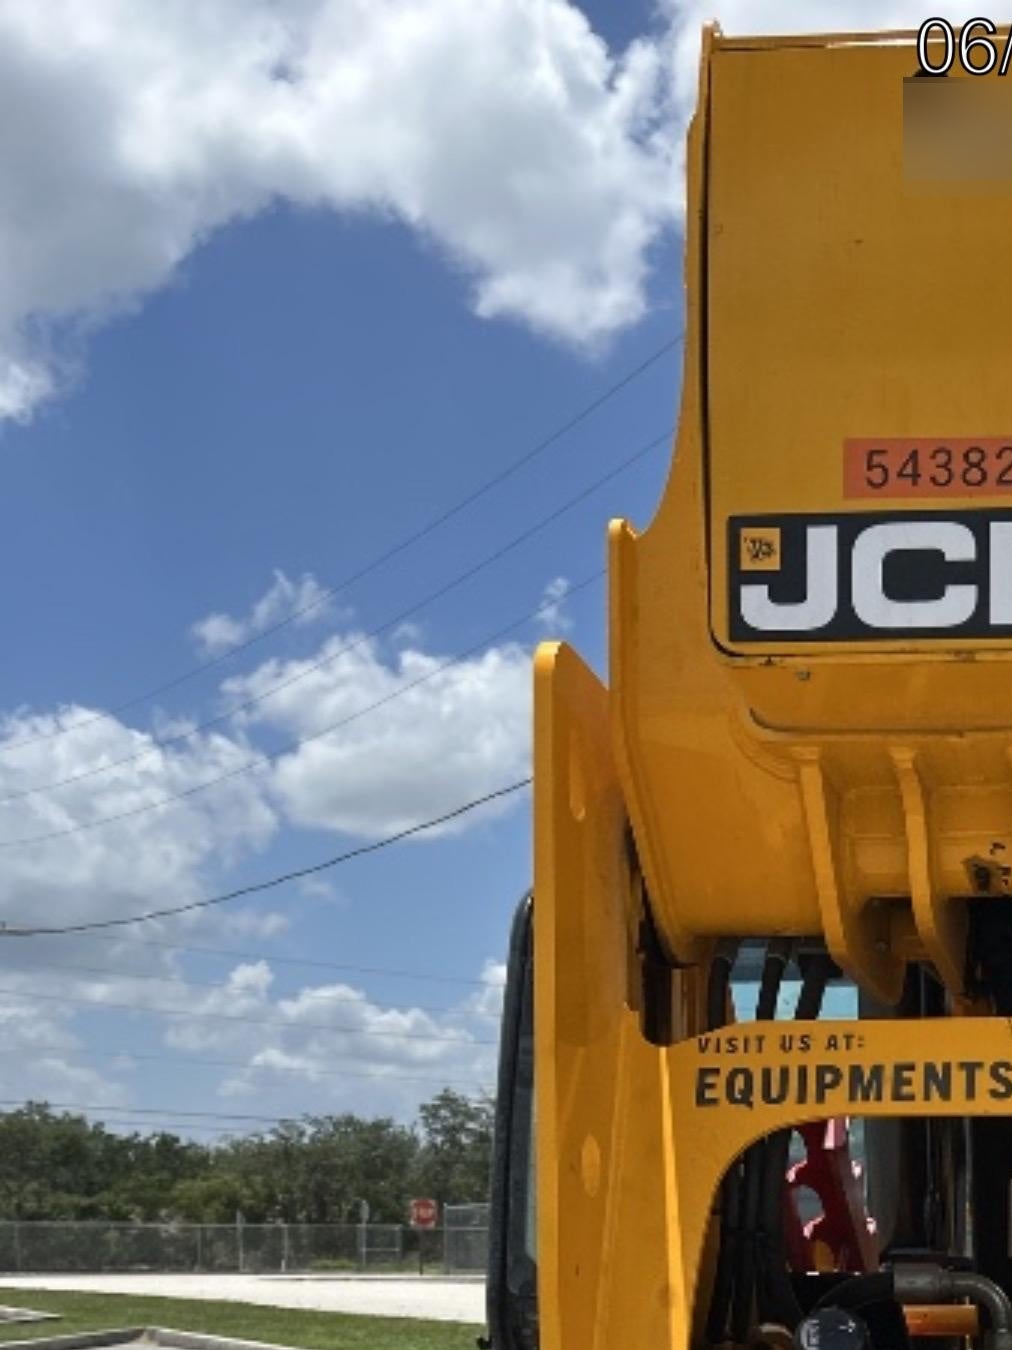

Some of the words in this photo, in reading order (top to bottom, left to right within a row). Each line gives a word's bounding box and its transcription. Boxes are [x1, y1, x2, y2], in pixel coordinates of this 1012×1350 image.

[698, 1035, 766, 1054] VISIT
[780, 1034, 812, 1052] US
[826, 1034, 864, 1051] AT:
